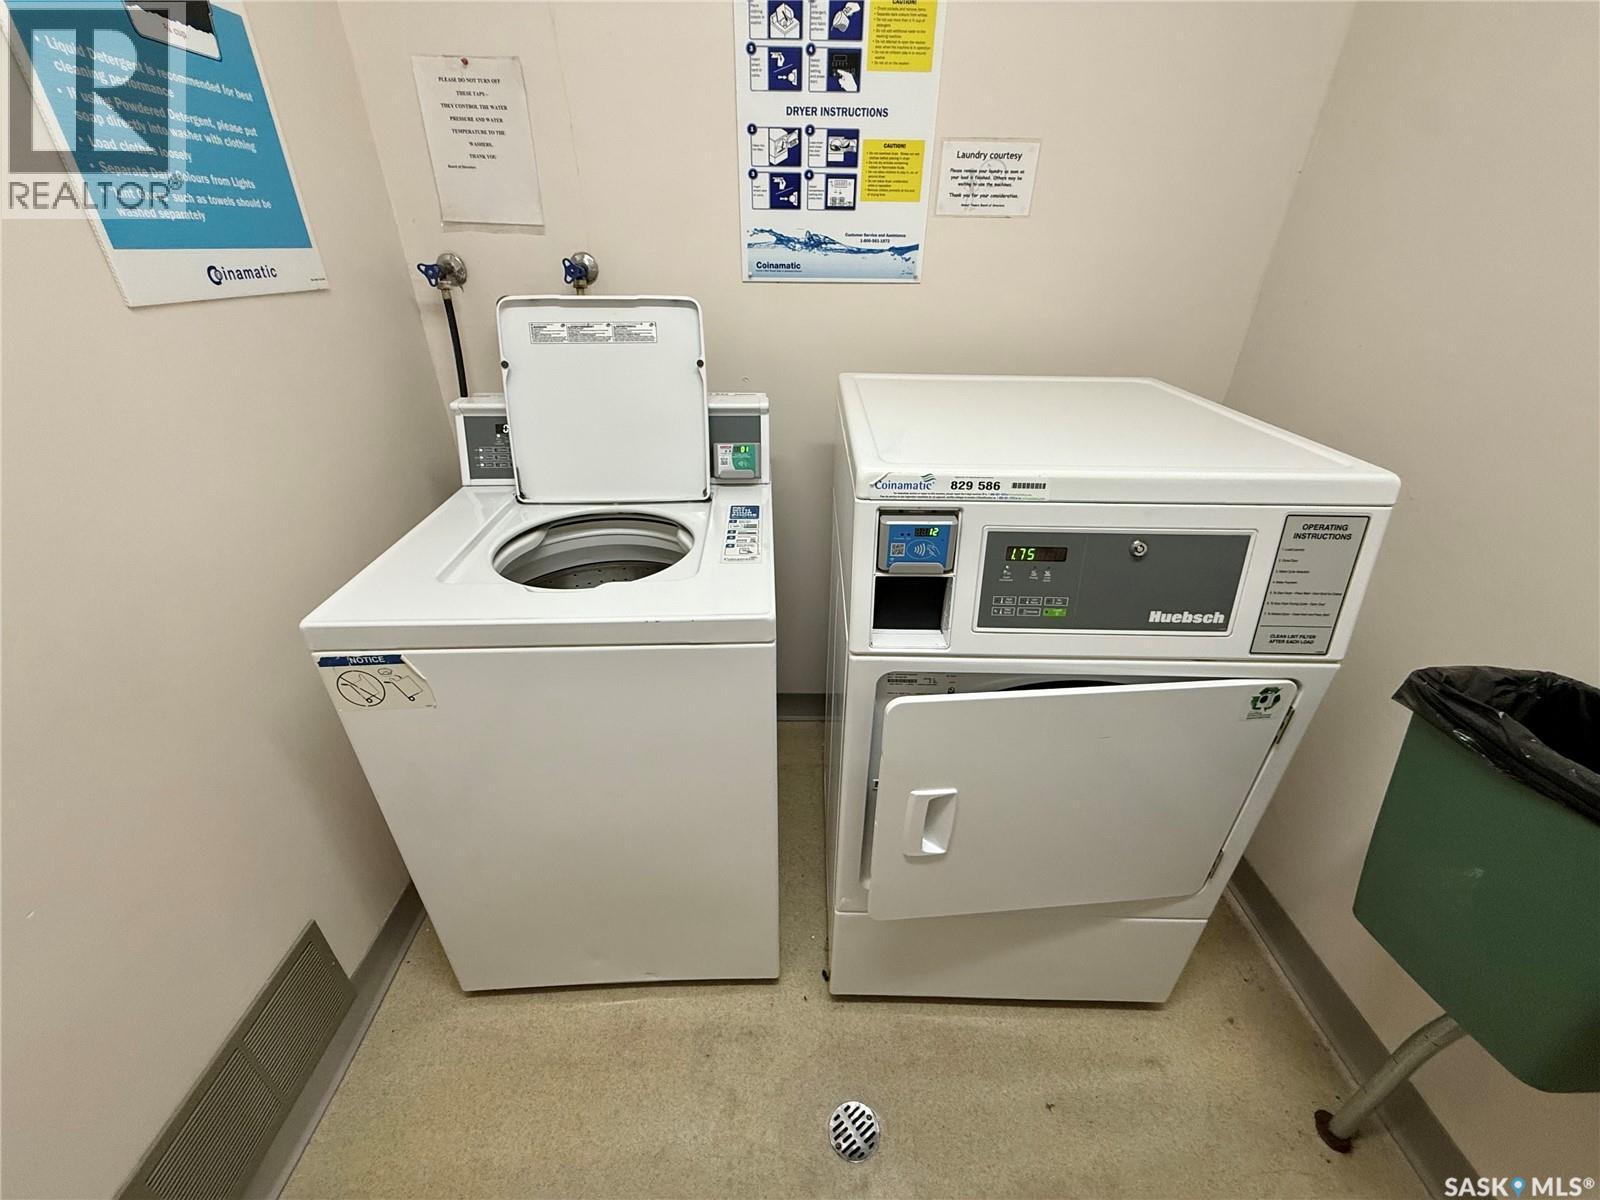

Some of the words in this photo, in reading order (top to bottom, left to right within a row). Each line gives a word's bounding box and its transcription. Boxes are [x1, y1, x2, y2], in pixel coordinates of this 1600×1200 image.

[44, 35, 86, 57] Liquid
[87, 46, 144, 73] Detergent
[144, 62, 156, 76] is
[157, 68, 222, 94] recommended
[222, 84, 235, 97] for
[235, 88, 254, 103] best
[54, 60, 108, 85] cleaning
[108, 72, 174, 98] performance
[114, 96, 166, 118] Powdered
[216, 120, 243, 134] please
[244, 127, 258, 138] put
[786, 106, 818, 117] DRYER
[820, 107, 889, 118] INSTRUCTIONS
[76, 111, 104, 127] soap
[106, 114, 146, 134] directly
[168, 128, 203, 142] washer
[204, 134, 223, 145] with
[224, 137, 257, 153] clothing
[88, 134, 117, 150] Load
[957, 150, 988, 160] Laundry
[990, 152, 1022, 161] courtesy
[98, 160, 148, 177] Separate
[175, 170, 210, 184] Colours
[210, 174, 230, 186] from
[231, 177, 256, 190] Lights
[172, 193, 195, 203] such
[196, 195, 208, 204] as
[208, 194, 236, 206] towels
[236, 197, 261, 208] should
[261, 199, 272, 209] be
[116, 208, 157, 217] washed
[158, 210, 206, 222] separately
[875, 480, 932, 490] Coinamatic
[950, 481, 973, 490] 829
[978, 481, 1001, 491] 586
[930, 528, 939, 536] 12
[1148, 610, 1225, 623] Huebsch
[349, 656, 386, 664] NOTICE
